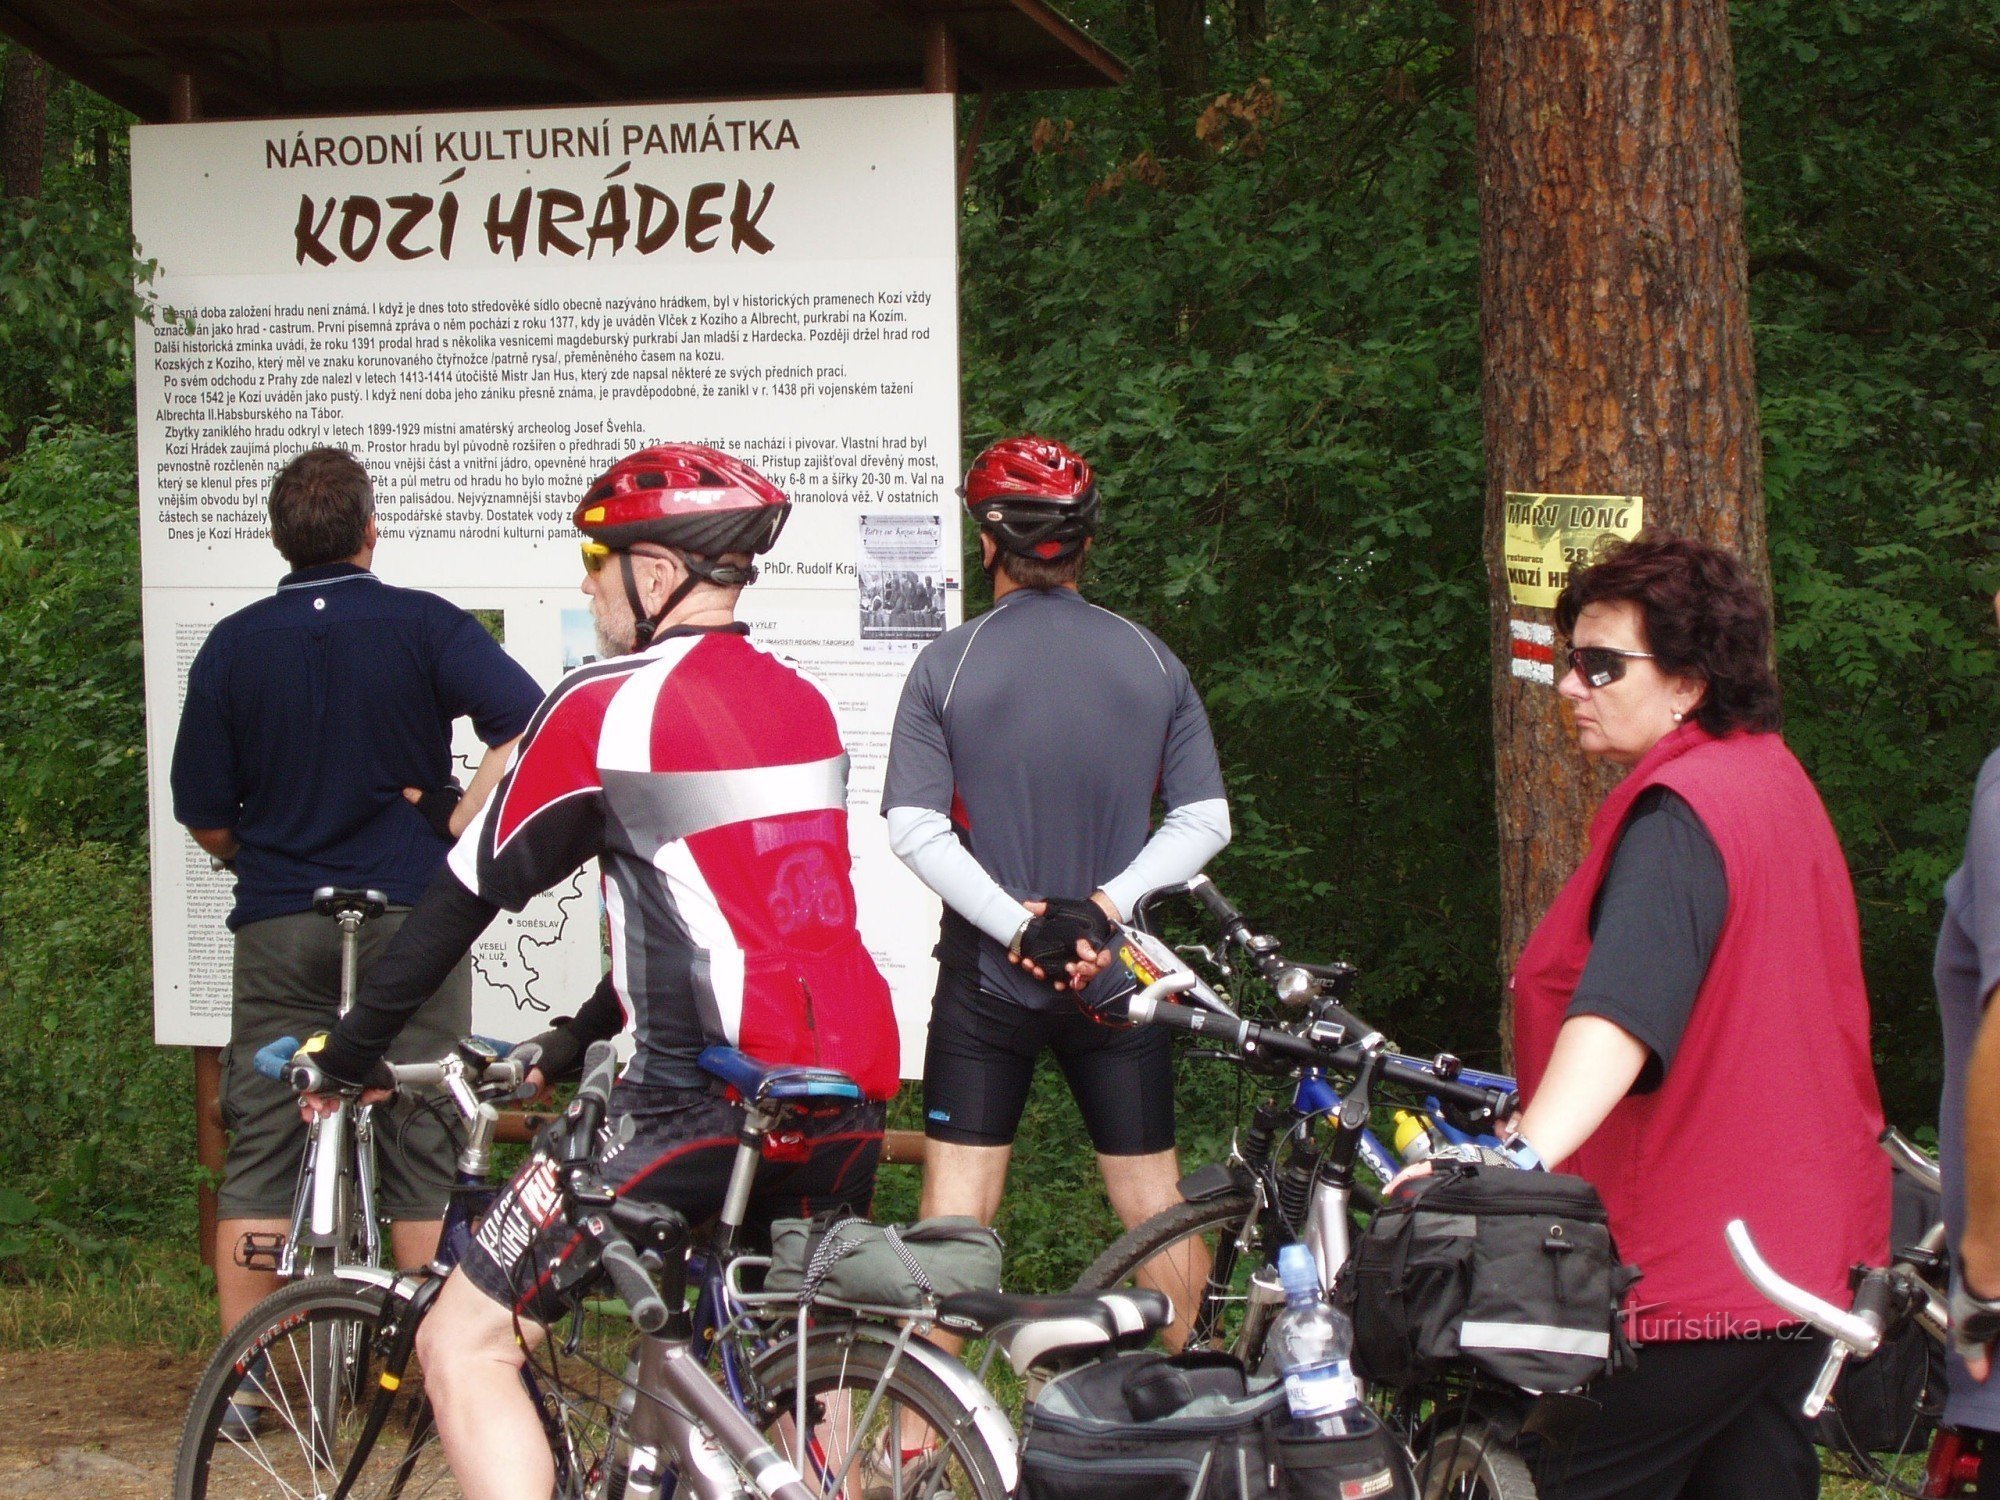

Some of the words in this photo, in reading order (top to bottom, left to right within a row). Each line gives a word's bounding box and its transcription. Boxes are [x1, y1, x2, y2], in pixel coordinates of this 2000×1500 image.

[266, 126, 422, 169] NÁRODNÍ
[435, 118, 610, 162] KULTURNÍ
[623, 114, 800, 155] PAMÁTKA
[295, 166, 466, 267] KOZÍ
[483, 160, 776, 262] HRÁDEK
[228, 303, 272, 318] založení
[274, 302, 304, 317] hradu
[332, 301, 370, 316] známá.
[472, 298, 530, 313] středověké
[534, 298, 560, 312] sídlo
[562, 297, 602, 311] obecně
[606, 296, 656, 314] nazýváno
[660, 294, 710, 313] hrádkem,
[742, 292, 810, 311] historických
[812, 291, 874, 310] pramenech
[270, 319, 316, 334] castrum.
[318, 318, 344, 333] První
[348, 317, 392, 335] písemná
[396, 317, 430, 334] zpráva
[468, 315, 510, 333] pochází
[616, 312, 656, 327] uváděn
[658, 312, 688, 326] Vlček
[700, 311, 738, 325] Kozího
[750, 309, 800, 327] Albrecht,
[804, 308, 850, 326] purkrabí
[870, 307, 906, 322] Kozím.
[154, 339, 180, 353] Další
[182, 338, 234, 353] historická
[236, 337, 272, 352] zmínka
[276, 336, 310, 354] uvádí,
[378, 334, 412, 352] prodal
[452, 333, 496, 348] několika
[500, 332, 554, 347] vesnicemi
[556, 330, 630, 348] magdeburský
[632, 329, 678, 347] purkrabí
[704, 328, 740, 343] mladší
[752, 327, 806, 342] Hardecka.
[810, 326, 850, 344] Později
[852, 325, 880, 340] držel
[154, 356, 204, 374] Kozských
[216, 355, 258, 372] Kozího,
[258, 354, 284, 372] který
[324, 353, 354, 367] znaku
[358, 351, 434, 367] korunovaného
[436, 350, 488, 368] čtyřnožce
[490, 349, 528, 367] /patrně
[564, 347, 638, 366] přeměněného
[640, 346, 676, 361] časem
[210, 372, 256, 387] odchodu
[268, 371, 298, 389] Prahy
[322, 370, 352, 385] nalezl
[364, 370, 396, 384] letech
[400, 368, 452, 384] 1413-1414
[456, 368, 498, 382] útočiště
[502, 367, 528, 382] Mistr
[580, 366, 608, 383] který
[632, 364, 668, 382] napsal
[672, 364, 712, 378] některé
[730, 363, 762, 380] svých
[766, 362, 814, 380] předních
[816, 361, 848, 379] prací.
[264, 389, 302, 404] uváděn
[330, 388, 364, 406] pustý.
[480, 385, 516, 400] zániku
[518, 385, 556, 402] přesně
[558, 384, 596, 402] známa,
[612, 382, 700, 401] pravděpodobné,
[718, 381, 748, 396] zanikl
[818, 379, 878, 397] vojenském
[880, 378, 914, 393] tažení
[156, 408, 206, 422] Albrechta
[208, 406, 292, 422] II.Habsburského
[310, 405, 344, 420] Tábor.
[164, 424, 200, 442] Zbytky
[202, 424, 252, 438] zaniklého
[254, 423, 284, 438] hradu
[288, 423, 320, 440] odkryl
[332, 422, 364, 437] letech
[368, 422, 420, 436] 1899-1929
[424, 421, 456, 436] místní
[460, 420, 514, 438] amatérský
[518, 420, 570, 437] archeolog
[574, 419, 604, 434] Josef
[606, 417, 646, 433] Švehla.
[190, 441, 228, 455] Hrádek
[230, 440, 270, 458] zaujímá
[274, 440, 308, 457] plochu
[368, 439, 406, 453] Prostor
[410, 438, 440, 453] hradu
[462, 438, 510, 455] původně
[512, 437, 556, 452] rozšířen
[568, 436, 620, 454] předhradí
[744, 435, 786, 449] nachází
[796, 434, 838, 452] pivovar.
[842, 434, 878, 448] Vlastní
[158, 458, 210, 476] pevnostně
[214, 458, 264, 472] rozčleněn
[394, 456, 426, 474] vnější
[464, 455, 498, 470] vnitřní
[500, 455, 532, 472] jádro,
[534, 454, 586, 472] opevněné
[762, 452, 800, 470] Přístup
[804, 452, 856, 469] zajišťoval
[860, 451, 904, 469] dřevěný
[158, 475, 184, 492] který
[200, 474, 232, 489] klenul
[420, 473, 450, 487] metru
[470, 473, 502, 487] hradu
[548, 472, 582, 486] možné
[832, 470, 858, 487] šířky
[158, 492, 198, 509] vnějším
[200, 492, 240, 506] obvodu
[400, 490, 454, 508] palisádou.
[458, 490, 542, 507] Nejvýznamnější
[794, 488, 848, 502] hranolová
[888, 487, 938, 502] ostatních
[158, 509, 198, 524] částech
[216, 509, 268, 526] nacházely
[446, 508, 484, 525] stavby.
[486, 507, 534, 522] Dostatek
[1507, 503, 1560, 528] MARY
[1569, 505, 1630, 530] LONG
[234, 525, 272, 539] Hrádek
[408, 525, 456, 542] významu
[460, 525, 500, 539] národní
[504, 524, 544, 538] kulturní
[1507, 554, 1544, 564] restaurace
[764, 562, 793, 575] PhDr.
[797, 561, 832, 575] Rudolf
[835, 562, 858, 578] Kraj
[1508, 567, 1541, 587] KOZÍ
[516, 917, 560, 928] SOBĚSLAV
[478, 942, 507, 950] VESELÍ
[489, 951, 507, 960] LUŽ.
